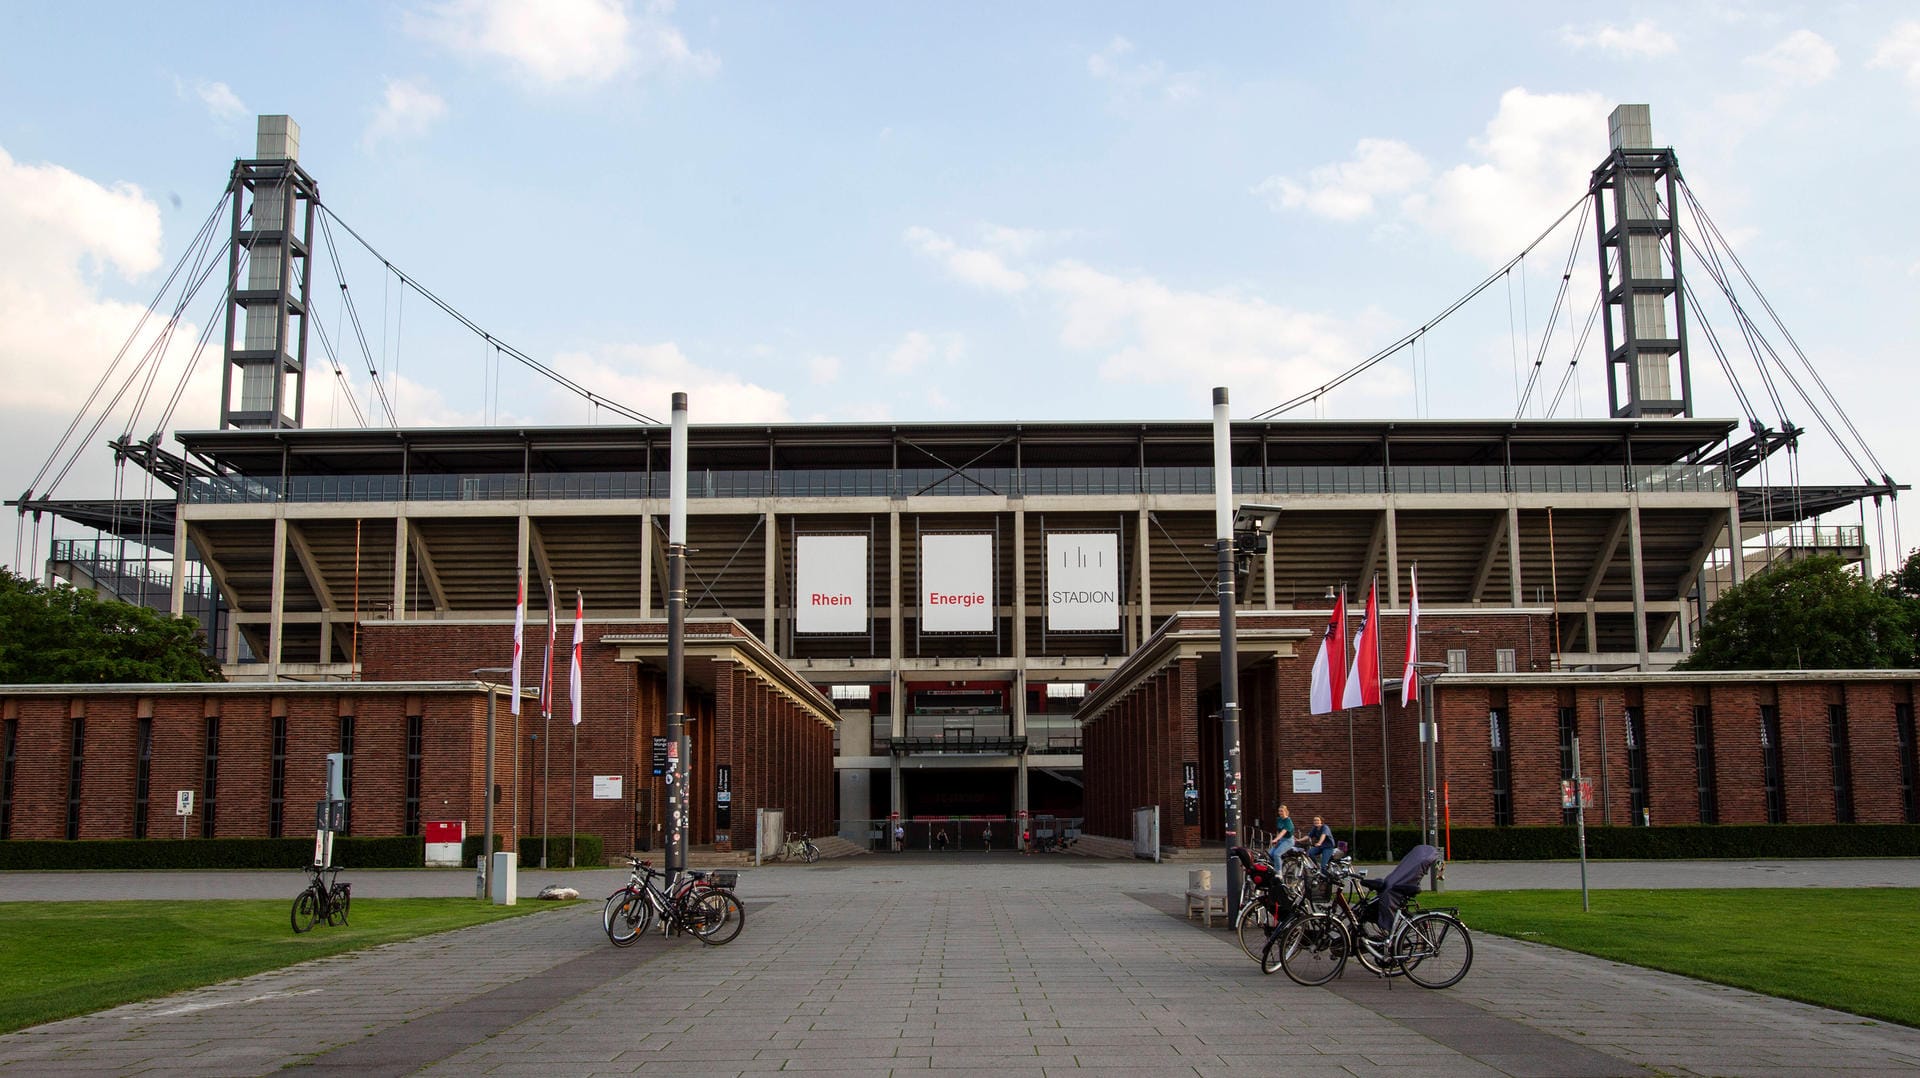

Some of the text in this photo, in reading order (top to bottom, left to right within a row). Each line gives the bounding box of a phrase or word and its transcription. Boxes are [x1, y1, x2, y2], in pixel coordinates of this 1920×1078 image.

[811, 593, 852, 606] Rhein
[930, 592, 985, 608] Energie
[1052, 591, 1114, 605] STADION
